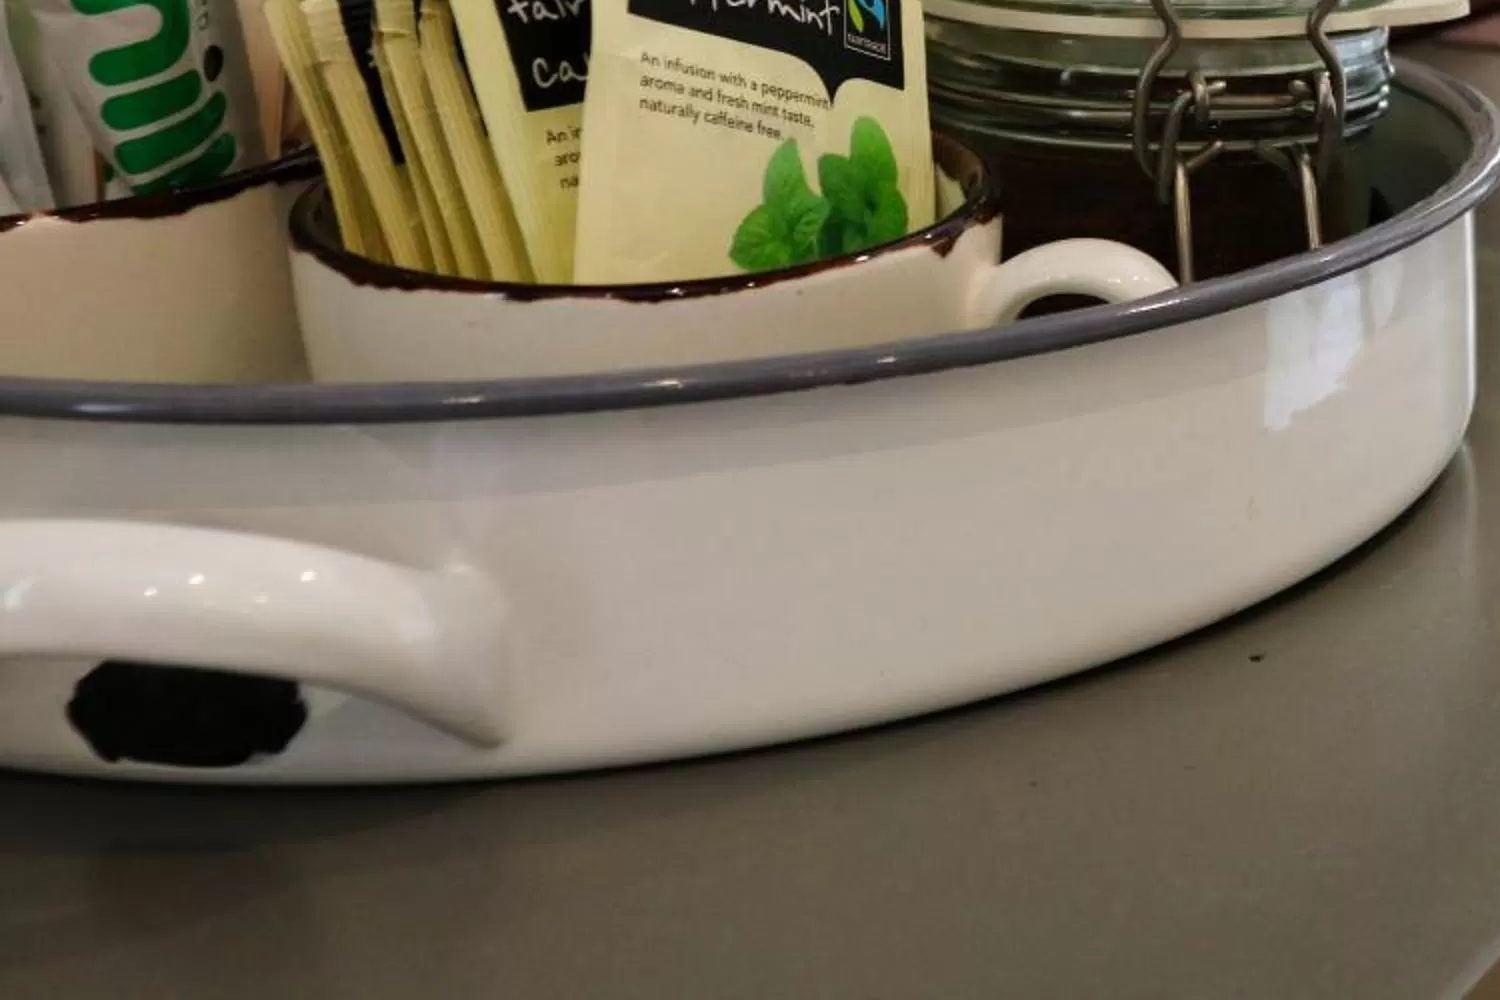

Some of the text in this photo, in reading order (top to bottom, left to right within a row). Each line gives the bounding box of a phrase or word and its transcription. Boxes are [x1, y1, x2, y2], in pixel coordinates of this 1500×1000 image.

[532, 53, 589, 88] Ca
[640, 51, 660, 67] An
[664, 56, 716, 81] infusion
[719, 71, 748, 89] with
[640, 75, 685, 95] aroma
[688, 87, 713, 103] and
[717, 87, 749, 110] fresh
[752, 102, 780, 117] mint
[640, 99, 700, 127] naturally
[704, 111, 753, 133] caffeine
